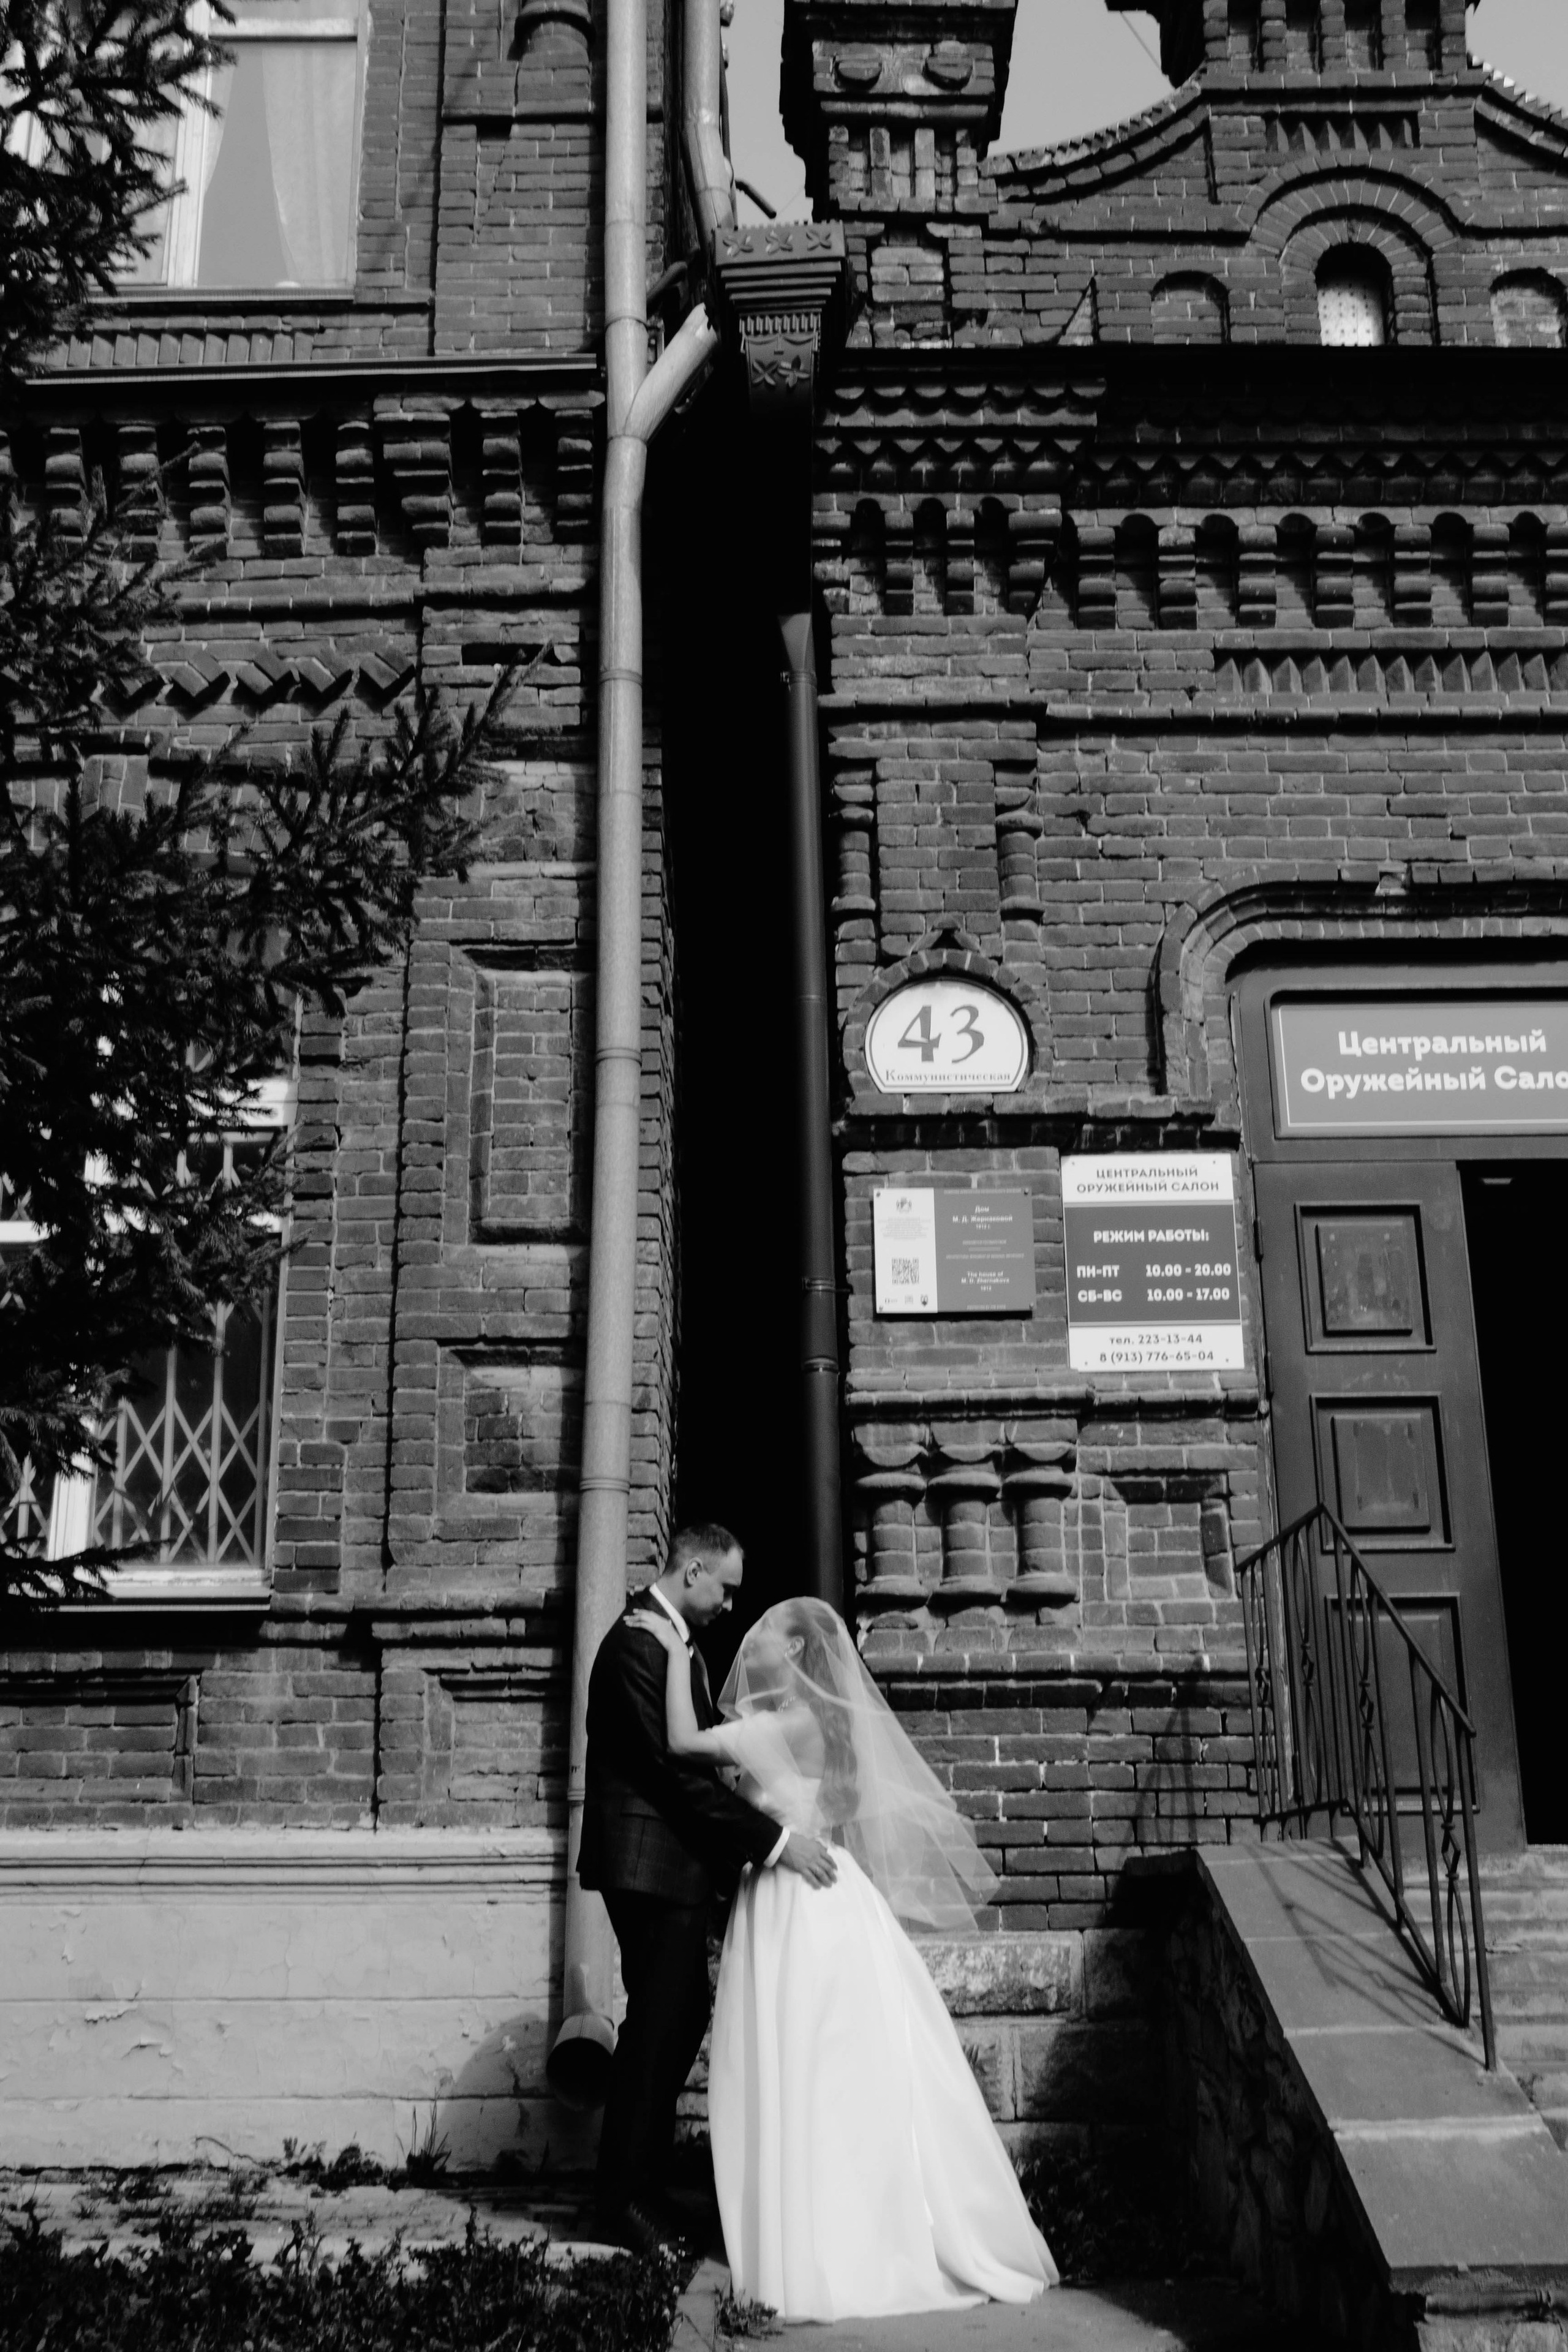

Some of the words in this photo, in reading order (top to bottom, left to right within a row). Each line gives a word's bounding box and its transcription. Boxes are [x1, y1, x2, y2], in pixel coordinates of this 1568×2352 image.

[897, 1005, 985, 1063] 43
[1338, 1029, 1547, 1061] Центральный
[886, 1069, 1011, 1085] Коммунистическая
[1300, 1066, 1487, 1099] Оружейный
[1096, 1165, 1198, 1178] ЦЕНТРАЛЬНЫЙ
[1077, 1179, 1167, 1193] ОРУЖЕЙНЫЙ
[1171, 1182, 1219, 1192] САЛОН
[1093, 1230, 1145, 1243] РЕЖИМ
[1148, 1229, 1210, 1242] РАБОТЫ:
[1077, 1265, 1120, 1278] ПН-ПТ
[1145, 1264, 1182, 1277] 10.00
[1194, 1263, 1231, 1276] 20.00
[1077, 1289, 1123, 1303] СБ-ВС
[1147, 1288, 1183, 1302] 10.00
[1196, 1287, 1230, 1301] 17.00
[1138, 1334, 1202, 1344] 223-13-44
[1100, 1353, 1106, 1362] 8
[1111, 1351, 1142, 1364] (913)
[1147, 1351, 1213, 1362] 776-65-04
